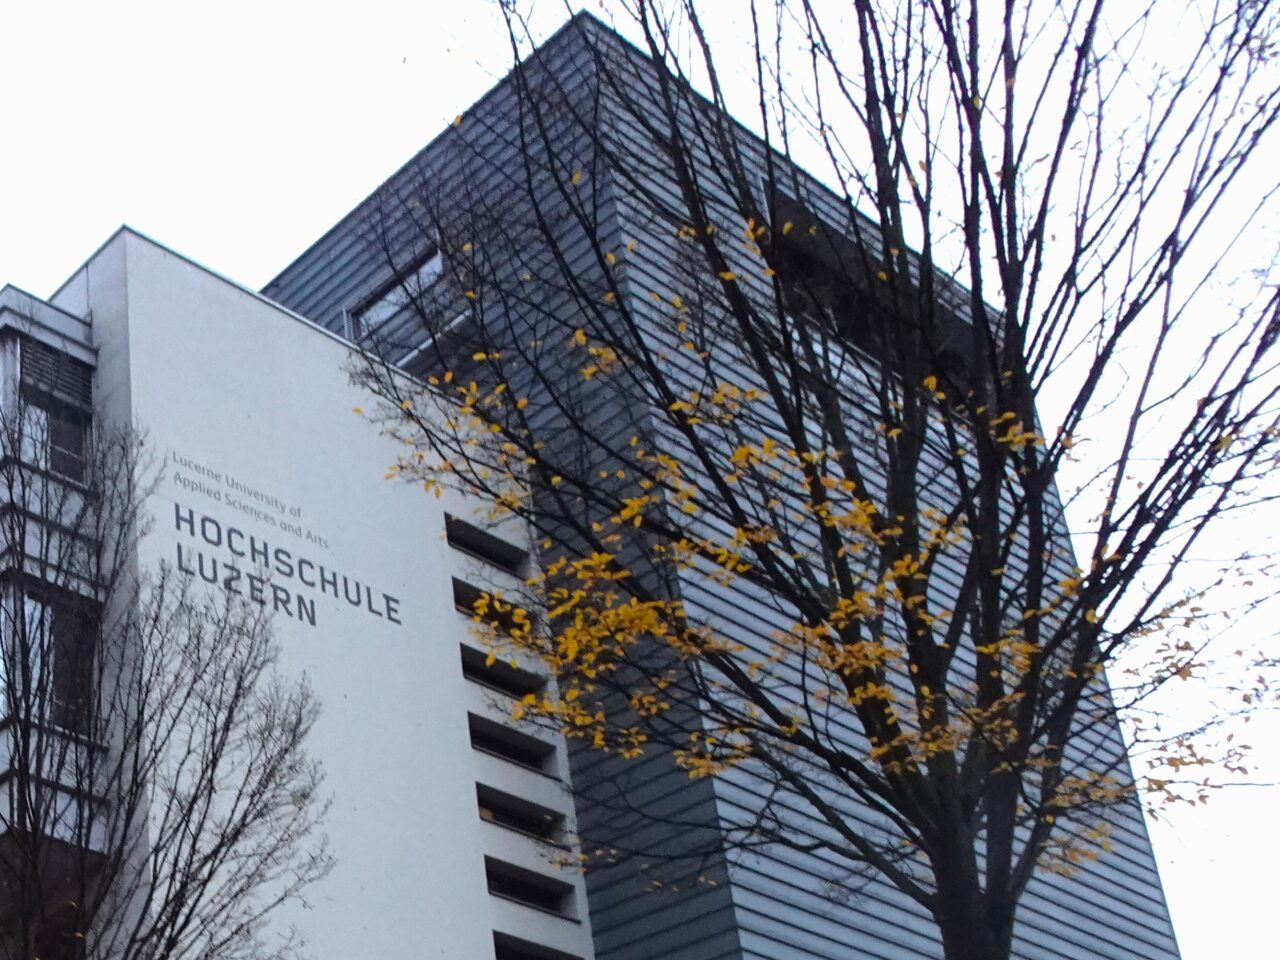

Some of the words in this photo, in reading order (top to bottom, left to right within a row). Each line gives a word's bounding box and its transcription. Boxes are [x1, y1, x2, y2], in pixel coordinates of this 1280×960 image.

[172, 450, 221, 482] Lucerne
[225, 474, 294, 515] University
[289, 505, 302, 519] of
[174, 471, 221, 502] Applied
[225, 494, 277, 527] Sciences
[280, 519, 302, 538] and
[305, 528, 329, 550] Arts
[174, 502, 402, 625] HOCHSCHULE
[177, 542, 317, 627] LUZERN
